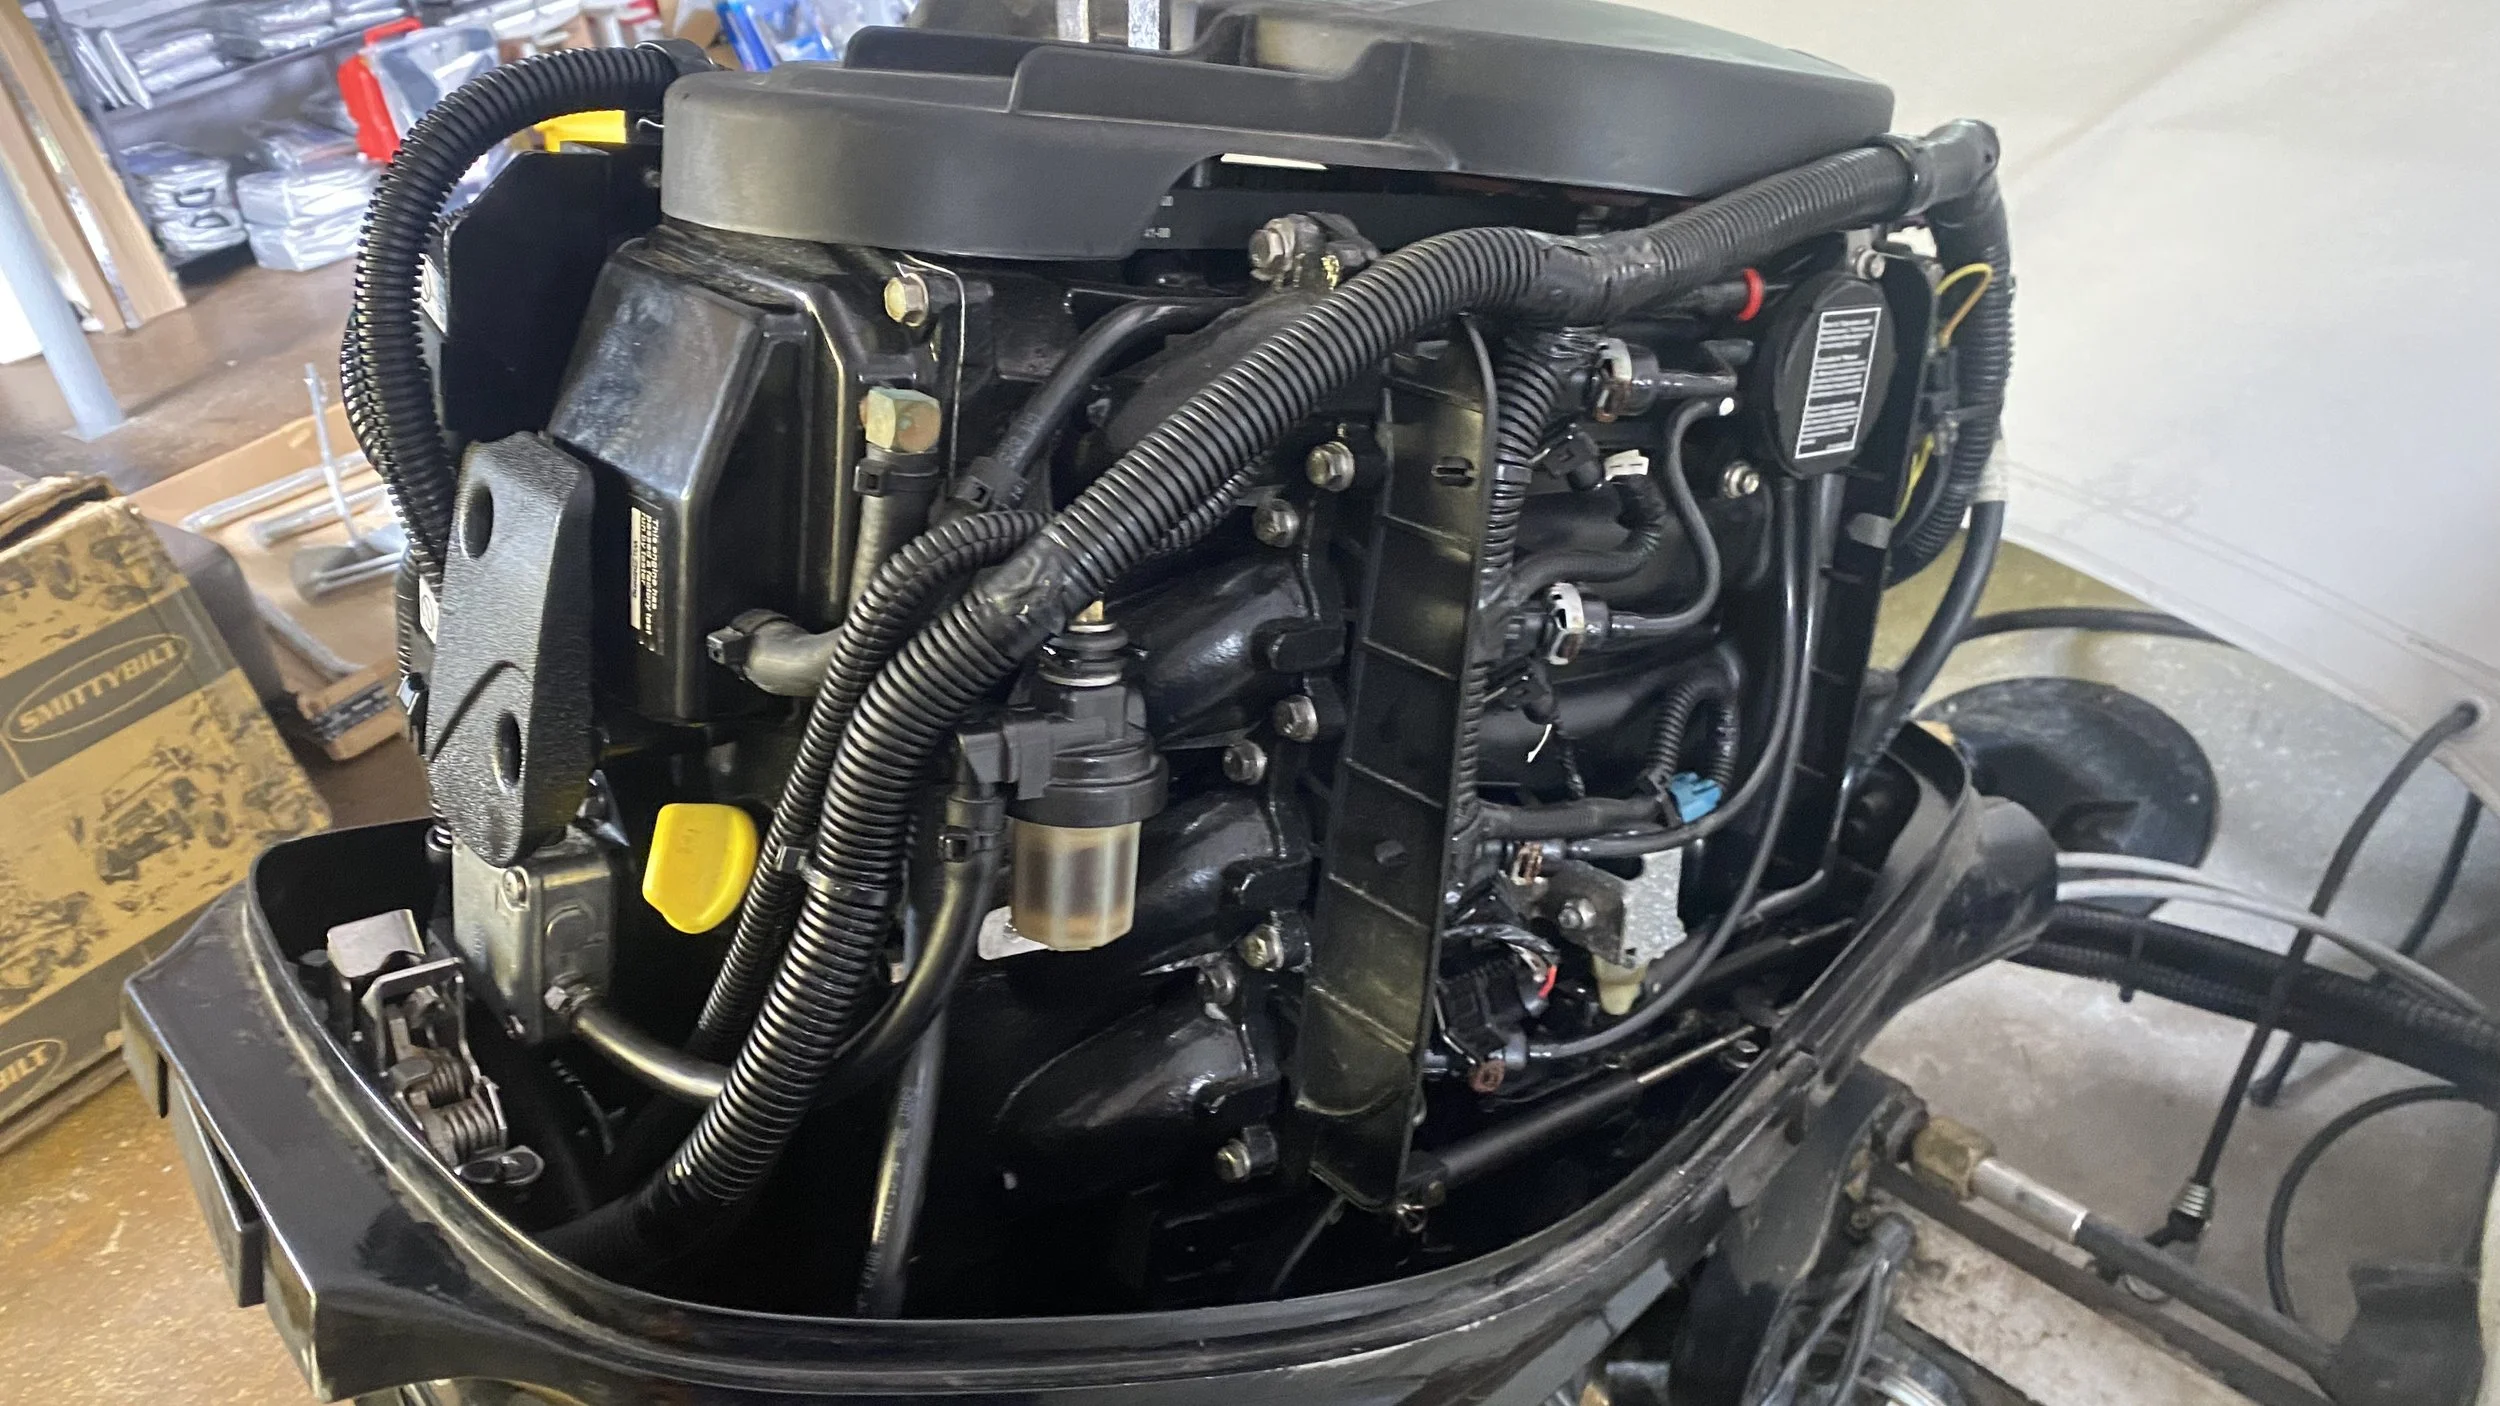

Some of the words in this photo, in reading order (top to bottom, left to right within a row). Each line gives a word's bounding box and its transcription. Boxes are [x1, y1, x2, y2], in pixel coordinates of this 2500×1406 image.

[645, 513, 653, 560] passed
[651, 545, 659, 587] engine
[644, 569, 652, 612] factory
[17, 639, 177, 734] SMITTYBILT
